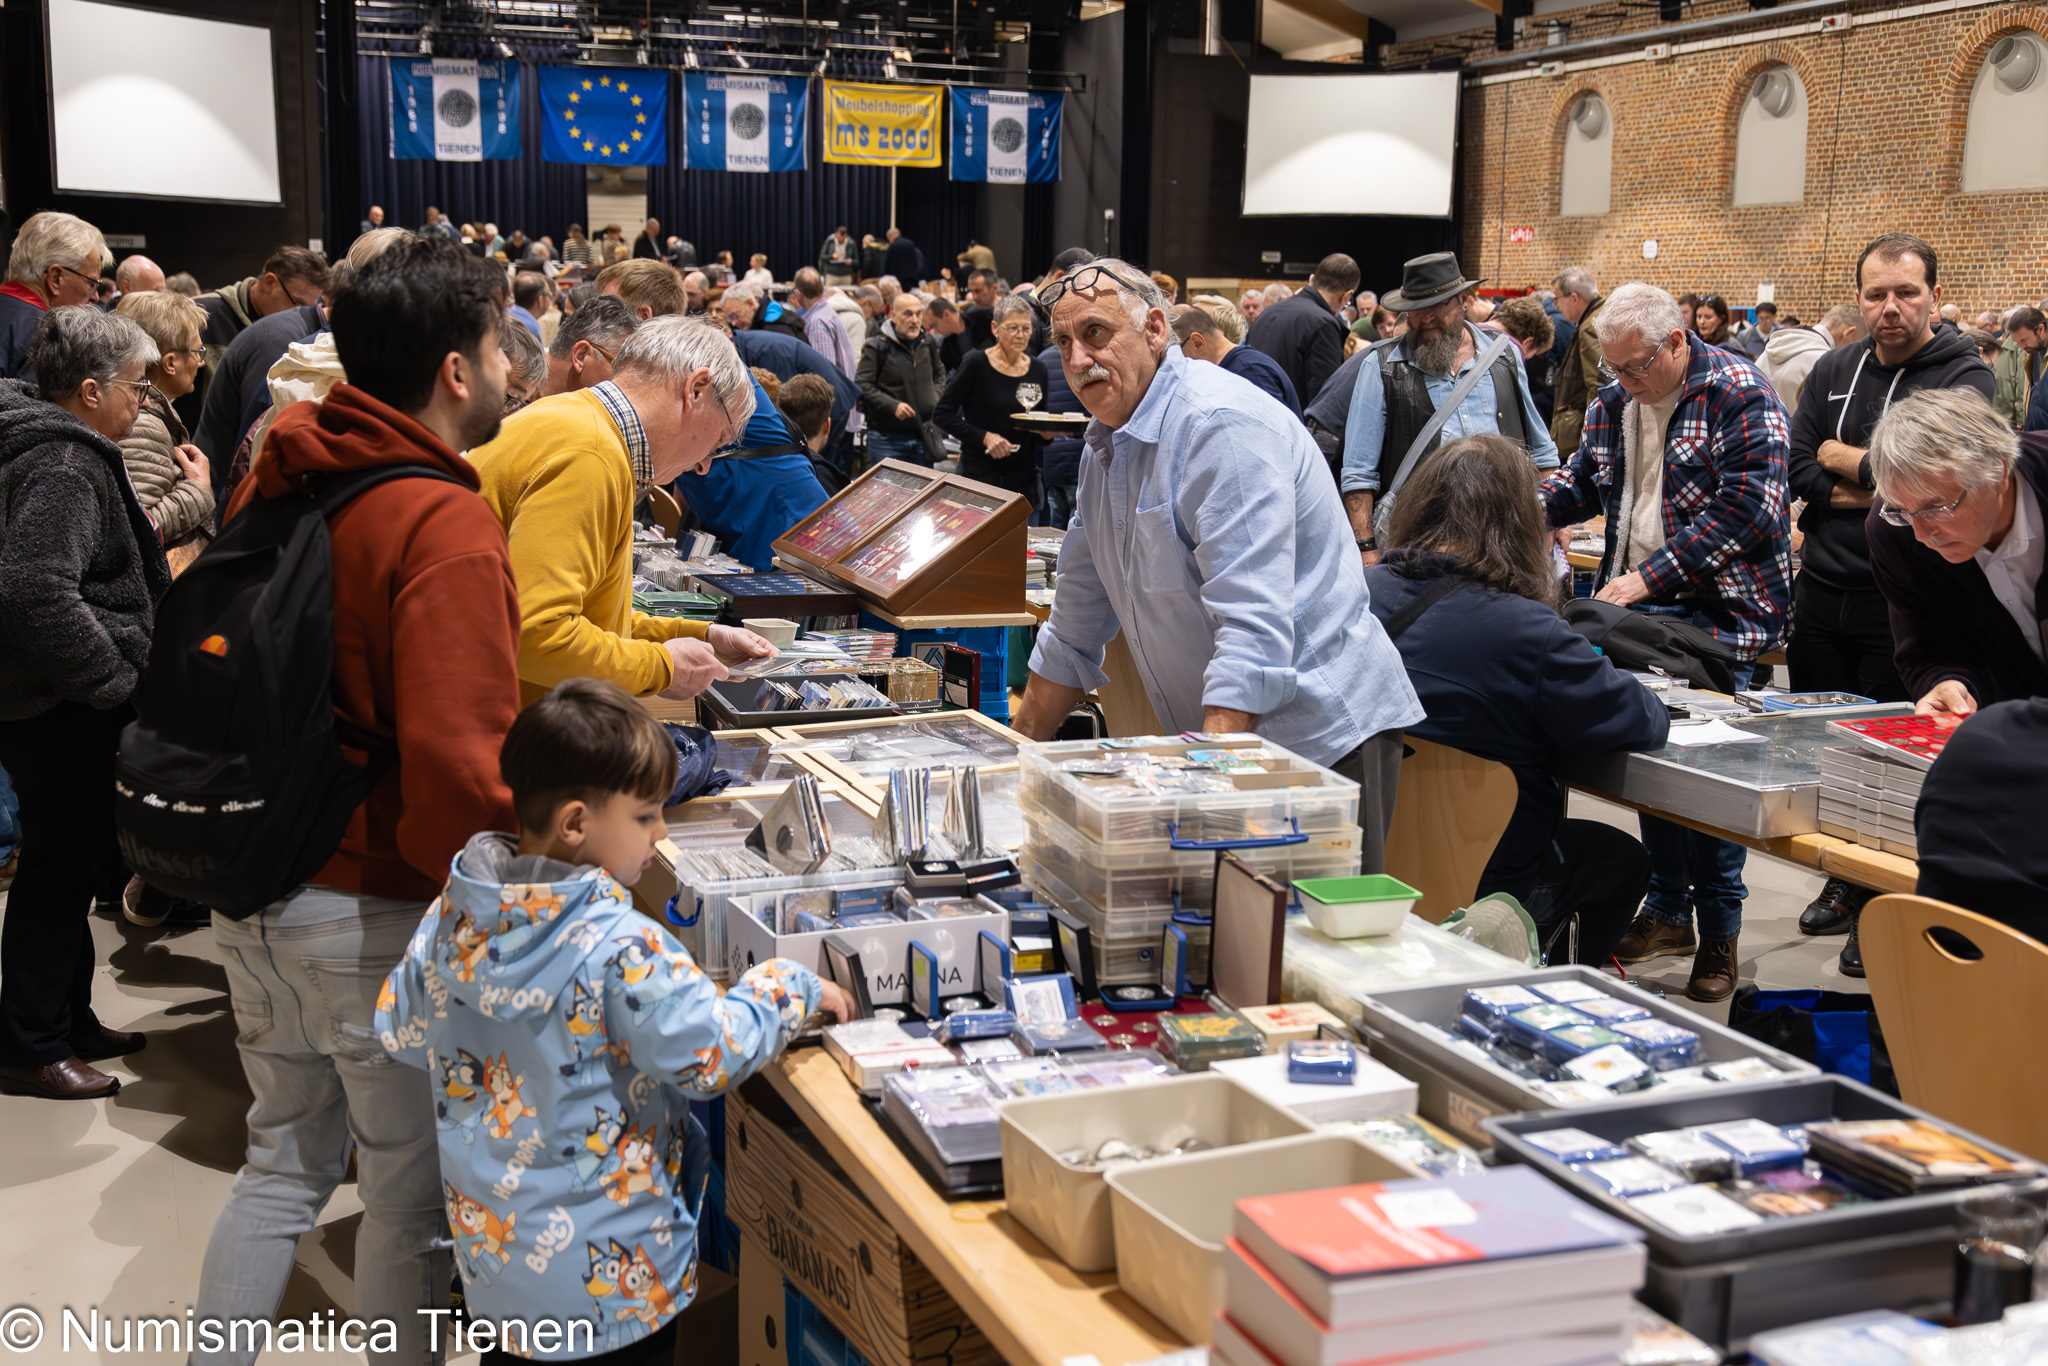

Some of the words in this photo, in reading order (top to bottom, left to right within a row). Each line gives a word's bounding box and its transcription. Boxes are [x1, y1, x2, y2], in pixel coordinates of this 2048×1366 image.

[706, 77, 788, 95] NUMISMATICA
[835, 96, 930, 118] Meubelshopping
[878, 126, 930, 151] 2000
[437, 143, 482, 155] TIENEN
[727, 153, 769, 165] TIENEN
[988, 166, 1026, 178] TIENEN
[524, 1205, 575, 1275] BLUEY
[766, 1212, 851, 1312] BANANAS
